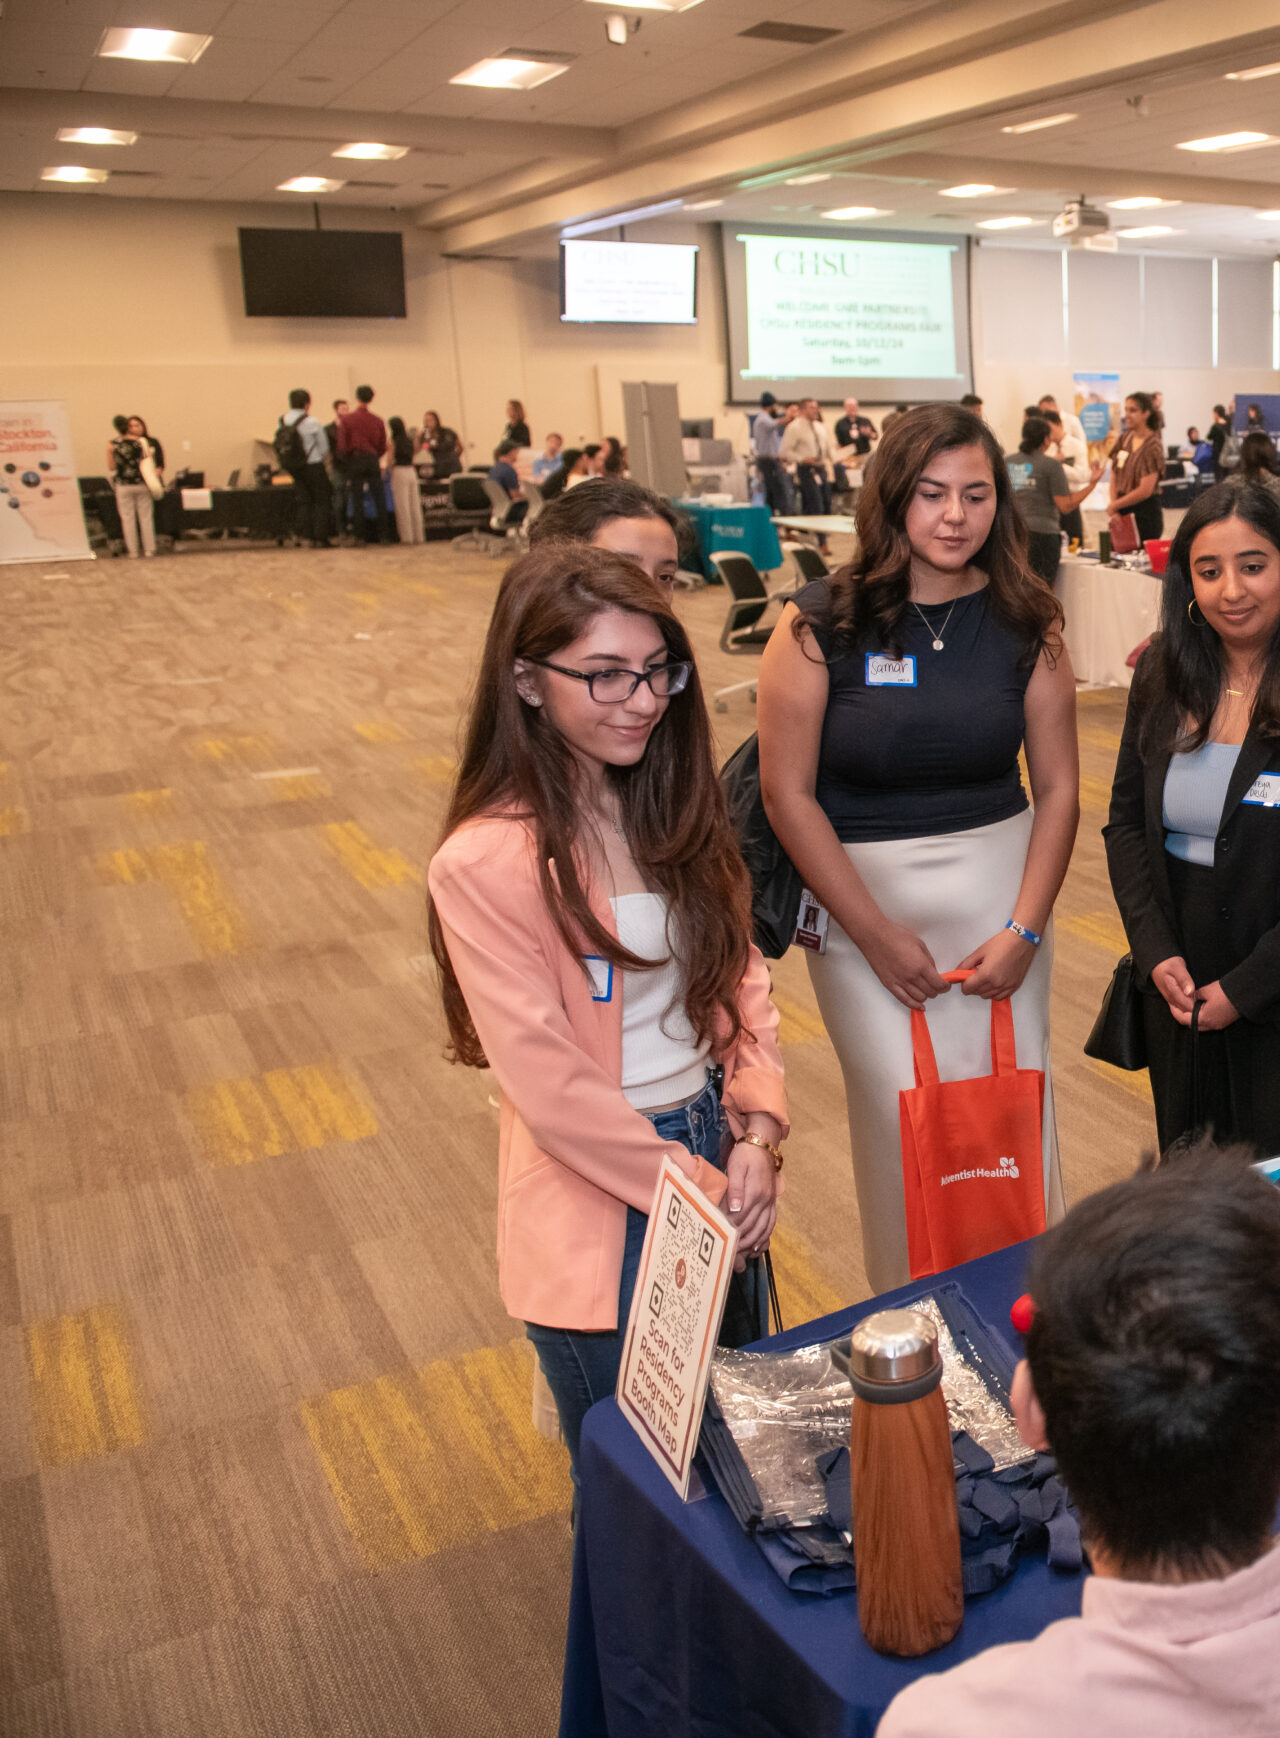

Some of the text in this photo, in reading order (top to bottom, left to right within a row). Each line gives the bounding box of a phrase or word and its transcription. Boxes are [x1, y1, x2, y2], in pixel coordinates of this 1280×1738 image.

[774, 250, 860, 278] CHSU
[640, 1334, 685, 1407] Residency
[648, 1318, 685, 1375] Scan for
[631, 1377, 677, 1454] Booth Map
[637, 1358, 679, 1427] Programs
